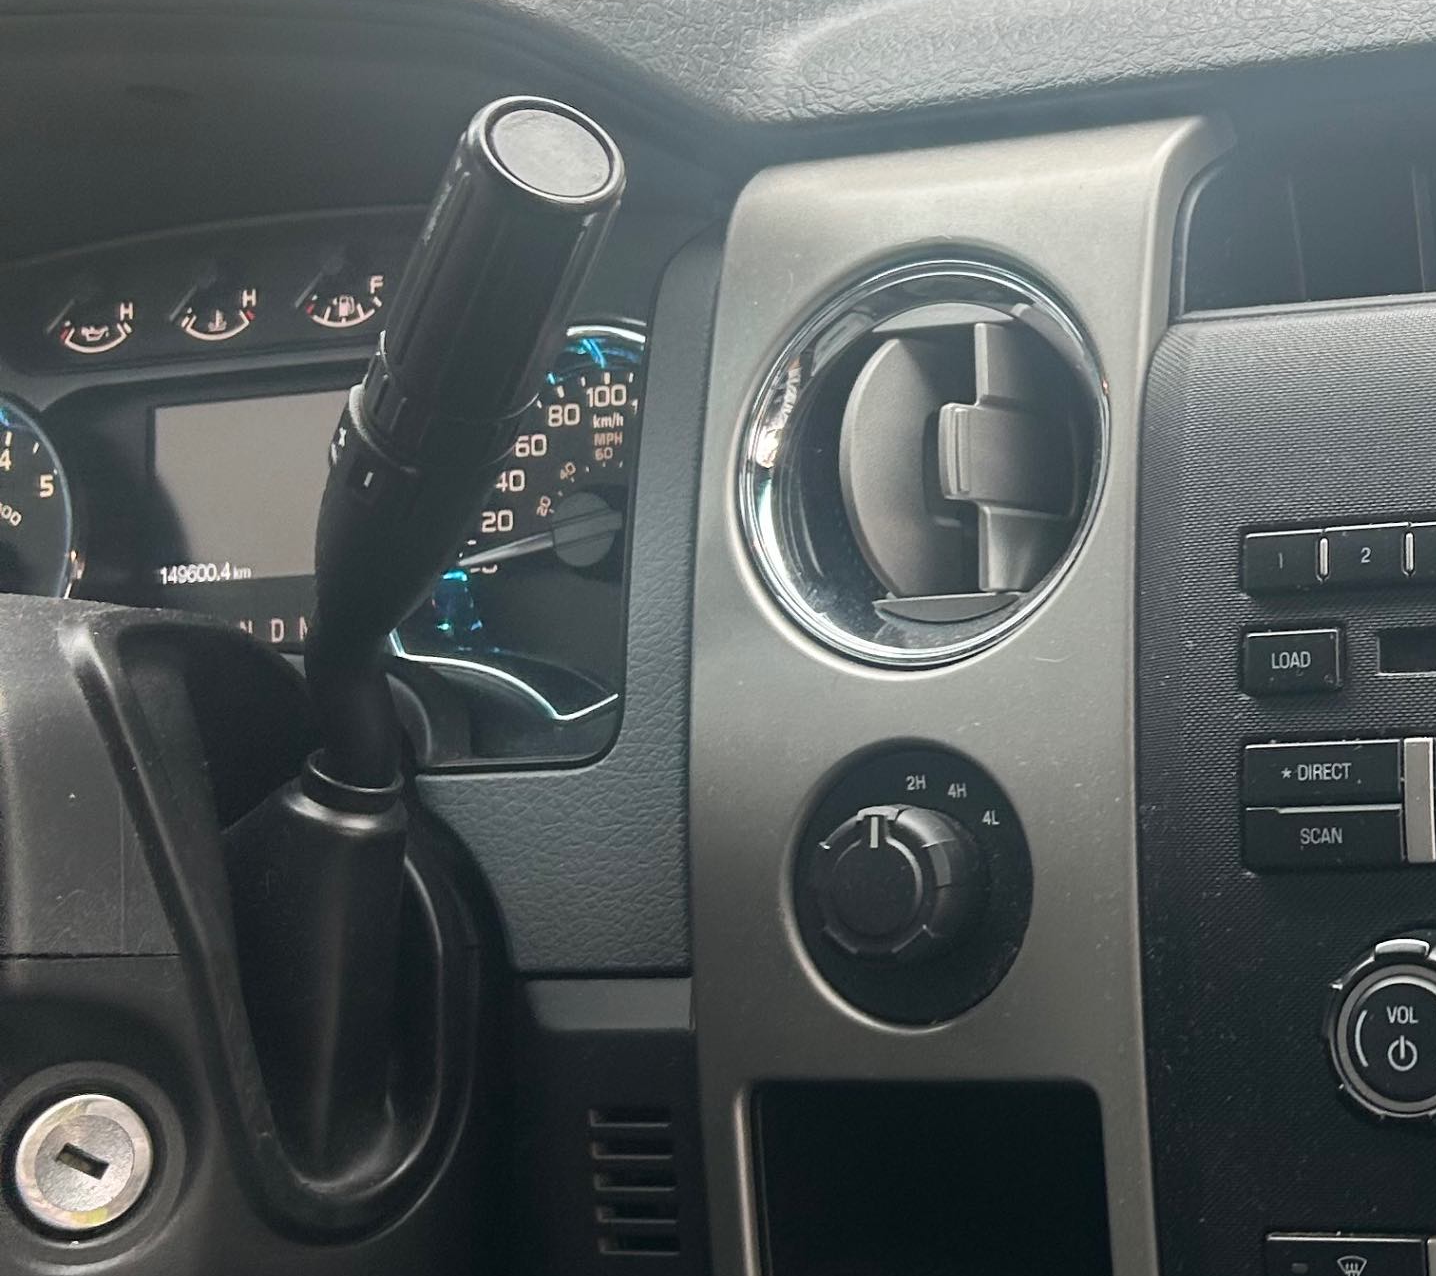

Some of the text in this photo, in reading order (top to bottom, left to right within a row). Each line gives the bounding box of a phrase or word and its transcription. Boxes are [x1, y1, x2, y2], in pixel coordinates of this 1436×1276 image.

[369, 275, 384, 294] F
[241, 288, 257, 308] H
[119, 302, 134, 321] H
[586, 383, 628, 408] 100
[547, 403, 581, 428] 80
[592, 411, 624, 429] km/h
[514, 433, 548, 459] 60
[593, 431, 623, 447] MPH
[594, 446, 614, 462] 60
[39, 475, 55, 498] 5
[495, 469, 526, 493] 40
[481, 509, 514, 533] 20
[1360, 546, 1373, 565] 2
[160, 562, 252, 585] 149600.4 km
[270, 618, 285, 643] D
[1270, 650, 1311, 670] LOAD
[1296, 761, 1352, 782] DIRECT
[906, 775, 927, 791] 2H
[947, 783, 967, 799] 4H
[981, 810, 1001, 827] 4L
[1299, 826, 1344, 845] SCAN
[1386, 1005, 1419, 1025] VOL
